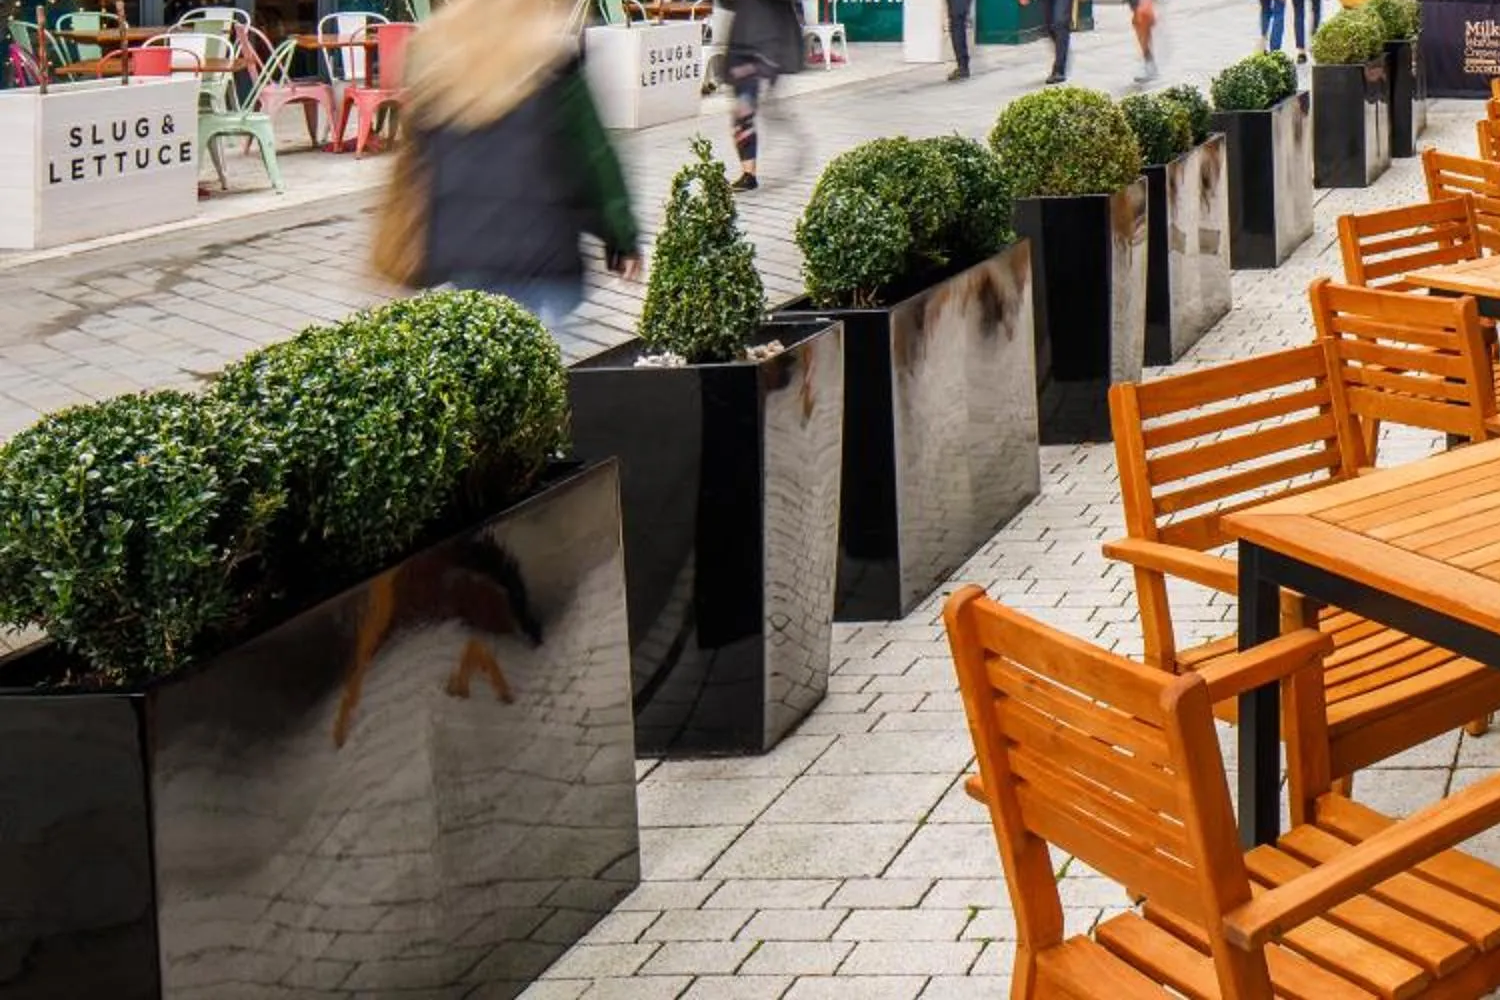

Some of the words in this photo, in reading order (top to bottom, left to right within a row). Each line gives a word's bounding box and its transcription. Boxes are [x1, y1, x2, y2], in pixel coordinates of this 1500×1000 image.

[650, 45, 683, 65] SLUG
[641, 63, 699, 87] LETTUCE
[69, 117, 149, 148] SLUG
[161, 114, 175, 135] &
[49, 141, 191, 184] LETTUCE
